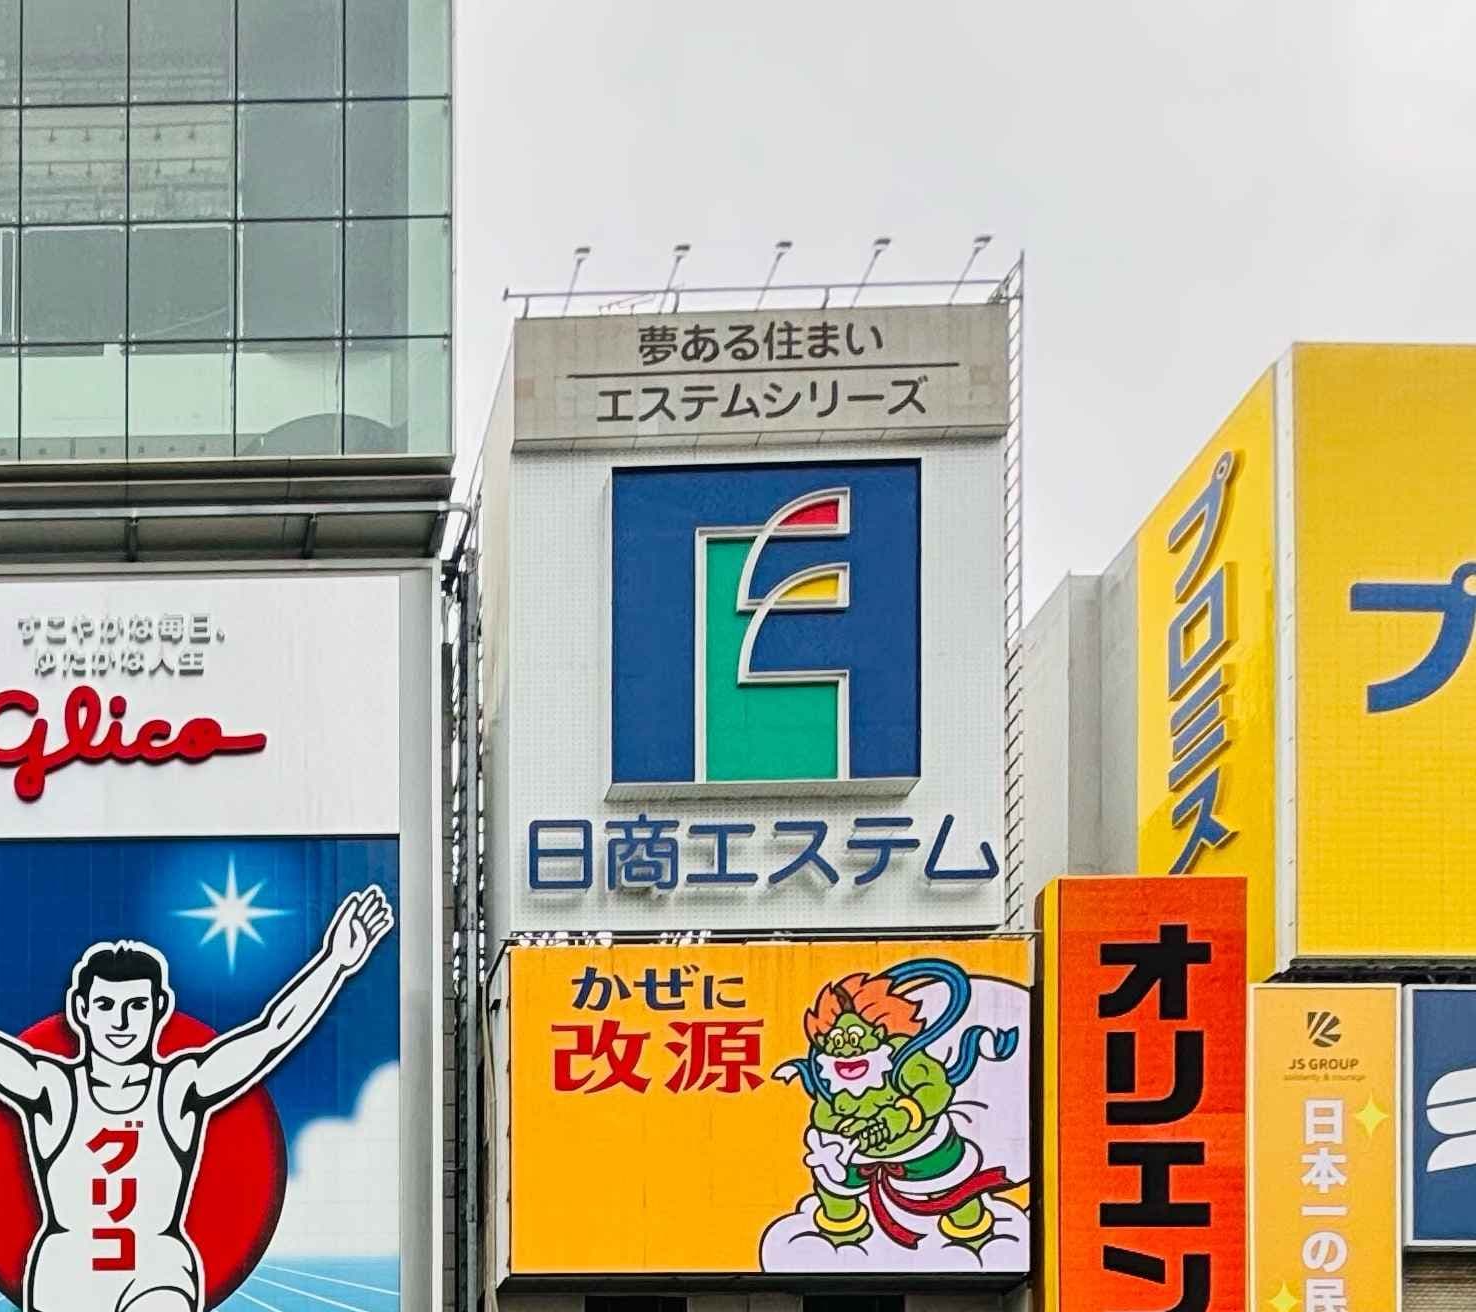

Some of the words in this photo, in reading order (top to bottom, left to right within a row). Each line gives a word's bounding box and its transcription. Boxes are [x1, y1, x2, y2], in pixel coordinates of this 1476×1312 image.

[638, 322, 883, 366] 夢ある住まい
[596, 375, 929, 422] エステムシリーズ
[35, 649, 204, 677] ゆたかな人生
[1168, 450, 1238, 875] プロミス
[528, 814, 1000, 891] 日商エステム
[571, 964, 747, 1012] かぜに
[551, 1018, 766, 1095] 改源
[1288, 1058, 1306, 1071] JS
[1308, 1058, 1360, 1071] GROUP
[86, 1120, 144, 1272] グリコ
